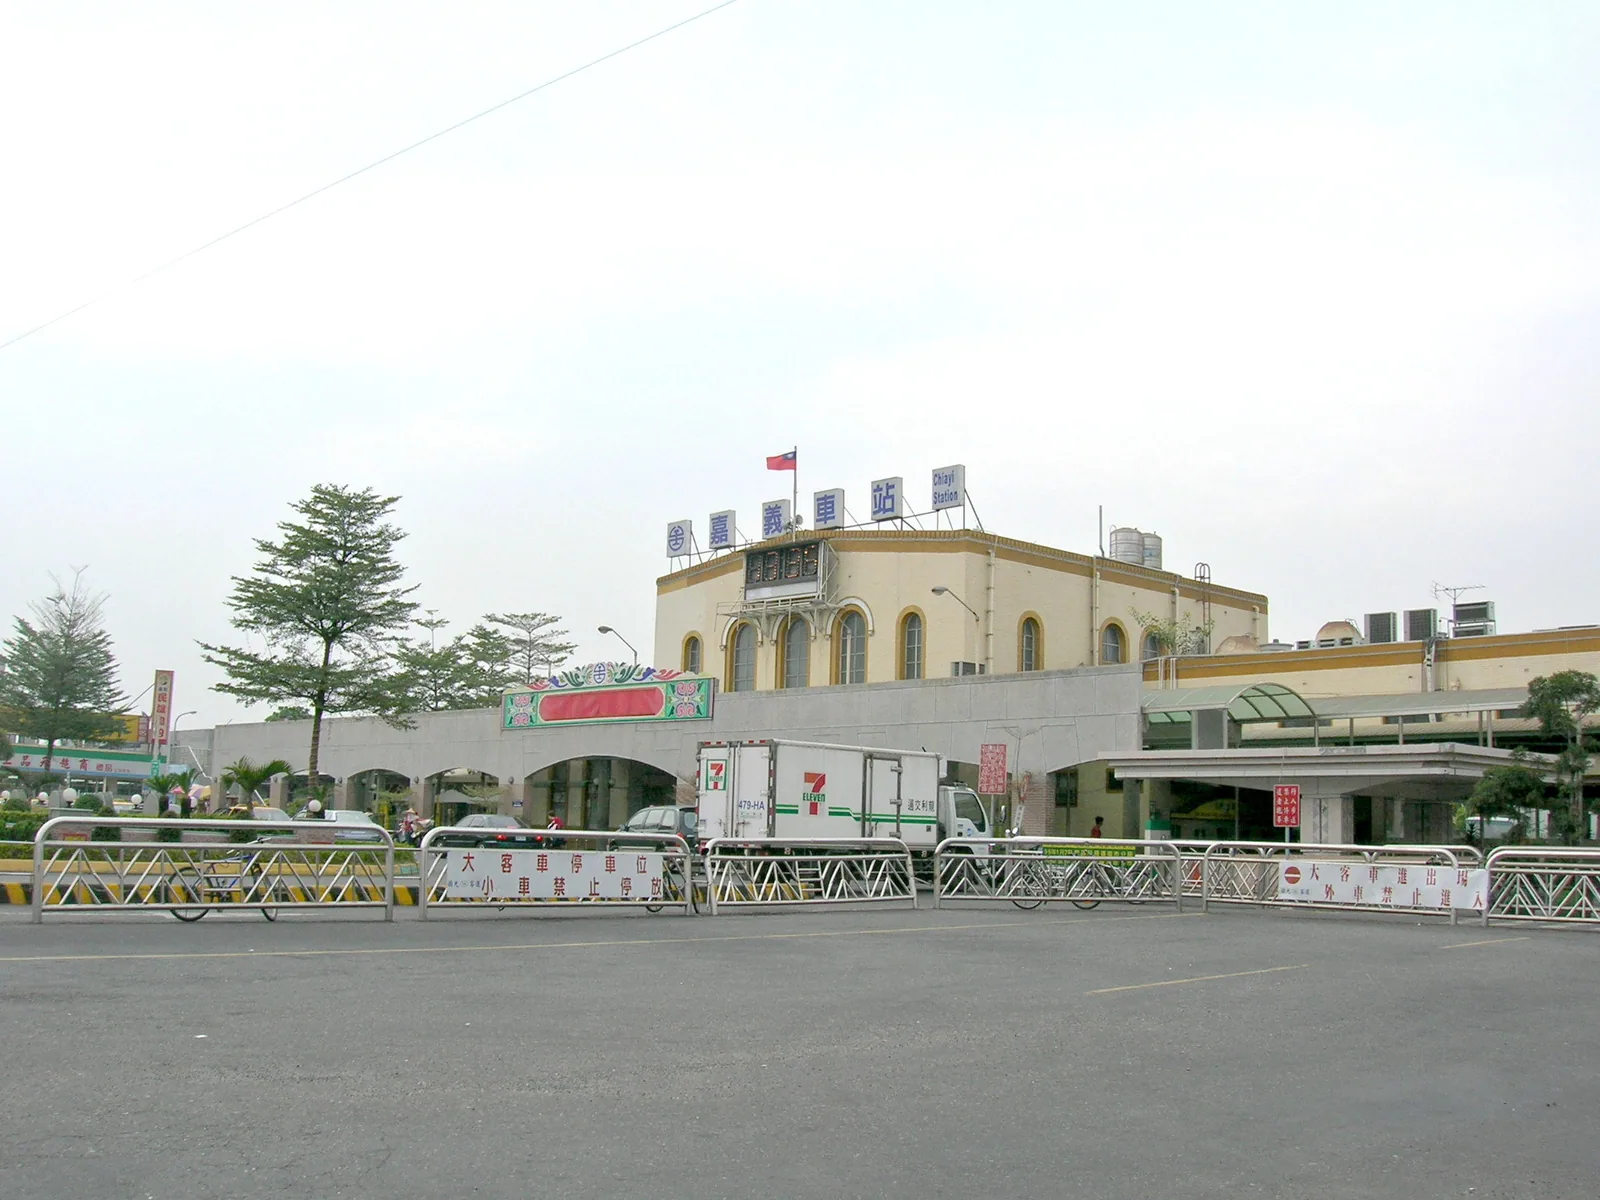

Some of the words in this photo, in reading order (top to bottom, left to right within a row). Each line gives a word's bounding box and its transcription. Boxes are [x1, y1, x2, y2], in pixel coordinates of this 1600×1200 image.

[933, 470, 954, 487] Chiayi
[933, 489, 958, 505] Station
[709, 482, 896, 545] 嘉義車站
[738, 800, 765, 810] 479-HA
[461, 852, 648, 874] 大客車停車位
[1309, 863, 1469, 886] 大客車進出場
[481, 875, 662, 897] 小車禁止停放
[1324, 884, 1484, 908] 外車禁止進入
